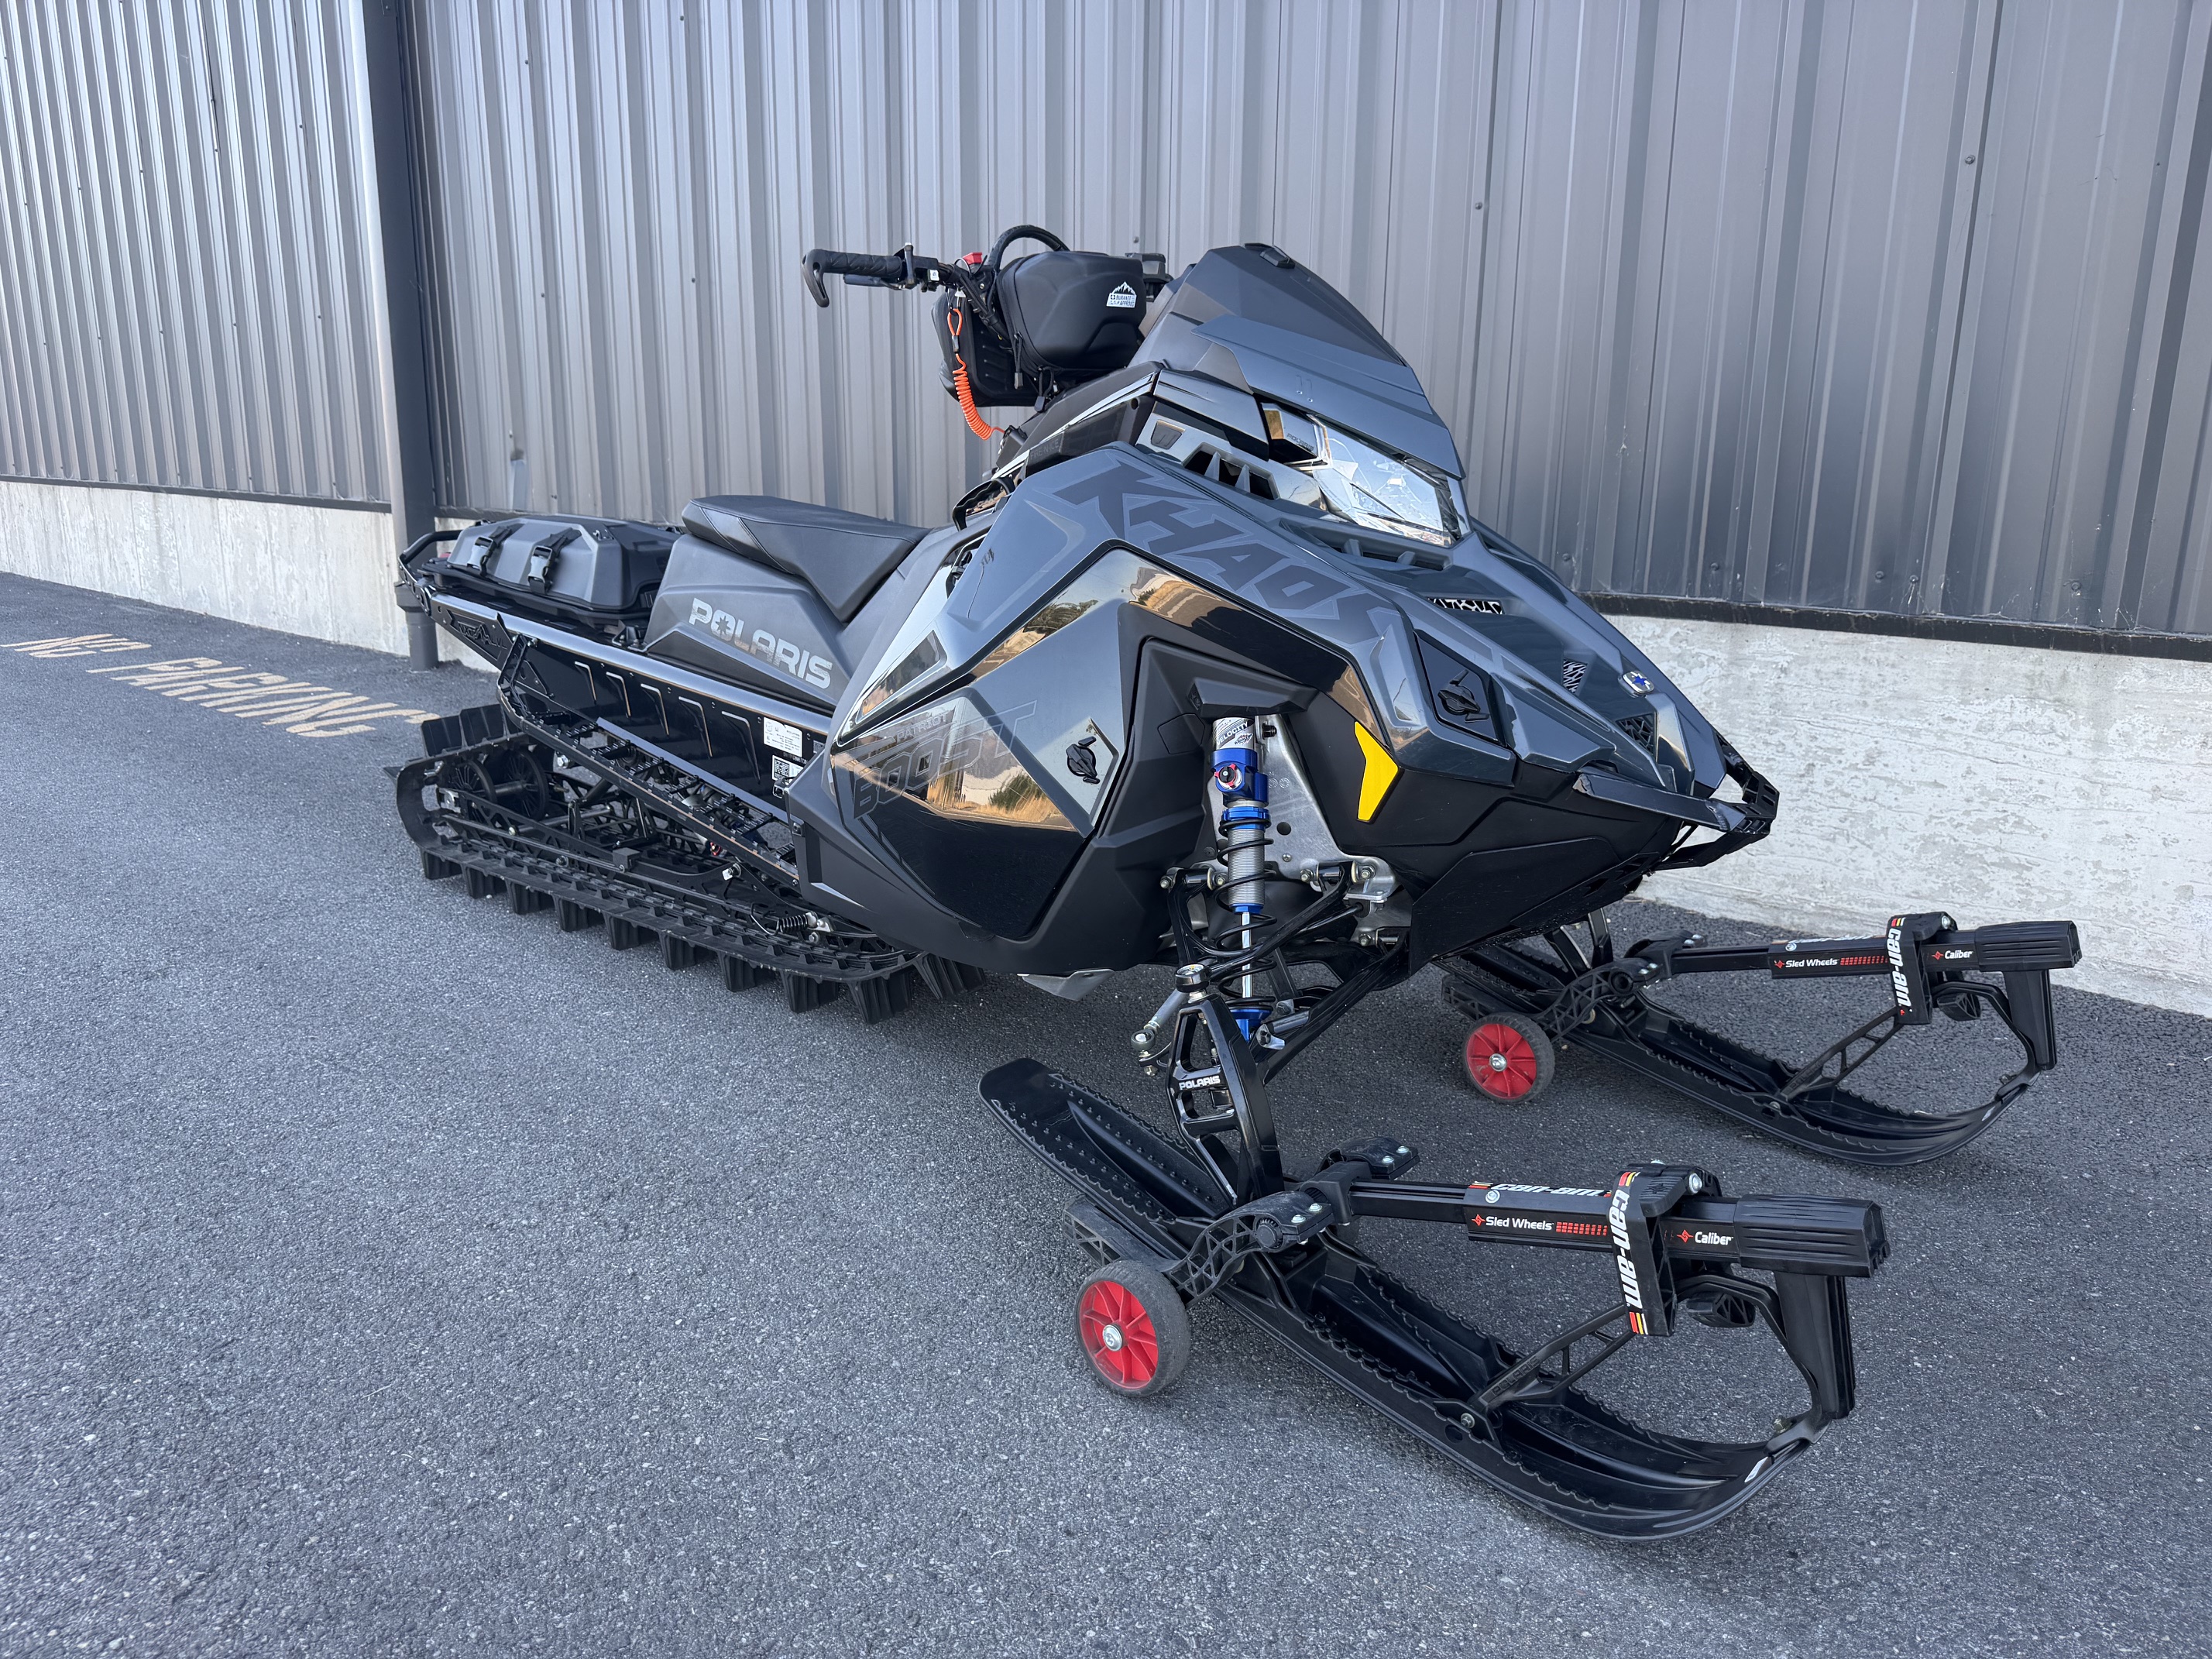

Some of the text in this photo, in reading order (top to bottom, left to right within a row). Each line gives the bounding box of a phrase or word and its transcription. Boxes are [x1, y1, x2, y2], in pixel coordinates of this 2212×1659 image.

[689, 597, 833, 689] POLARIS
[0, 633, 441, 737] NO PARKING
[896, 713, 949, 743] PATRIOT
[1216, 721, 1248, 745] VELOCITY
[854, 700, 1037, 819] BOOST
[1785, 958, 1838, 968] Sled Wheels
[1945, 950, 1973, 959] Caliber
[1887, 928, 1911, 1007] can-am
[1179, 1075, 1221, 1091] POLARIS
[1491, 1183, 1605, 1197] can-am
[1486, 1216, 1552, 1230] Sled Wheels
[1609, 1189, 1643, 1309] can-am
[1695, 1231, 1732, 1245] Caliber
